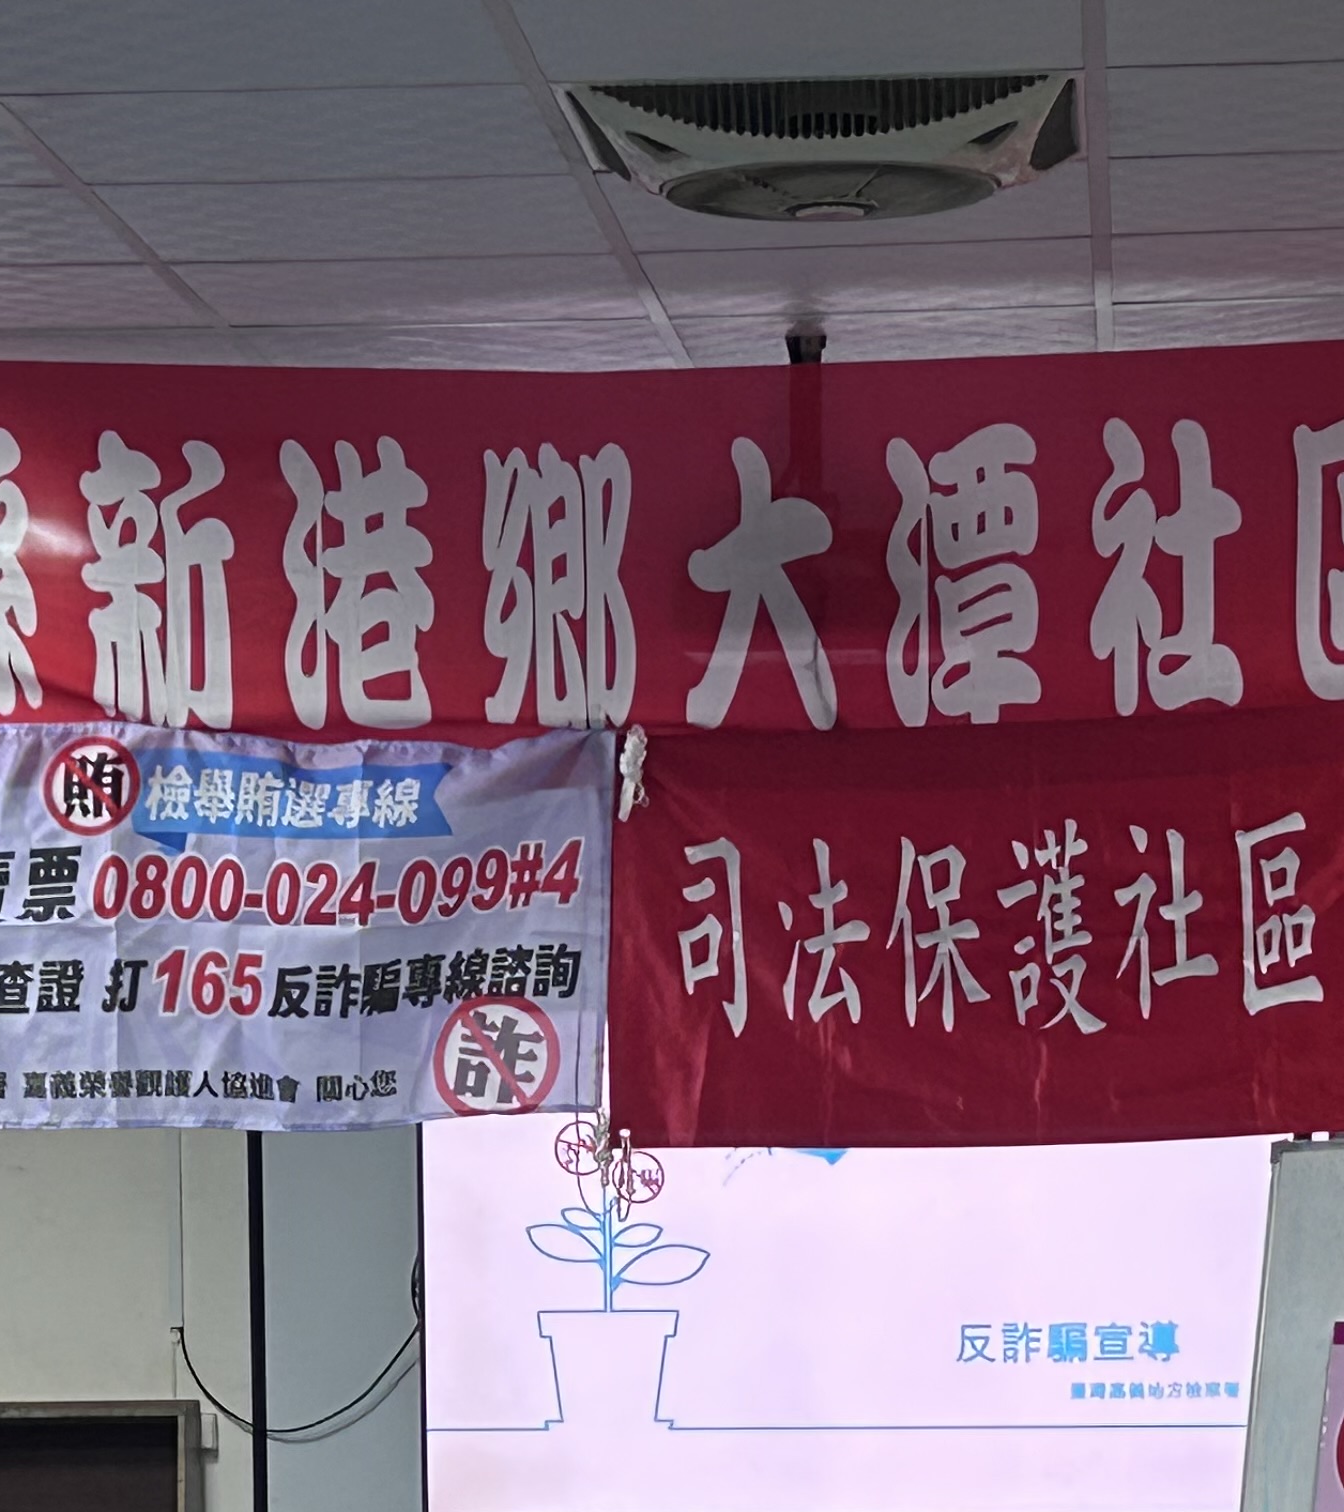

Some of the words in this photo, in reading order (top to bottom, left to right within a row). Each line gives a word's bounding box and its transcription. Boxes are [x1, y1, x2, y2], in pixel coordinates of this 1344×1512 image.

[63, 751, 124, 819] 賄
[145, 763, 422, 829] 檢舉賄選專線
[93, 838, 584, 927] 0800-024-099#4
[455, 1011, 545, 1104] 詐
[956, 1320, 1180, 1363] 反詐騙宣導
